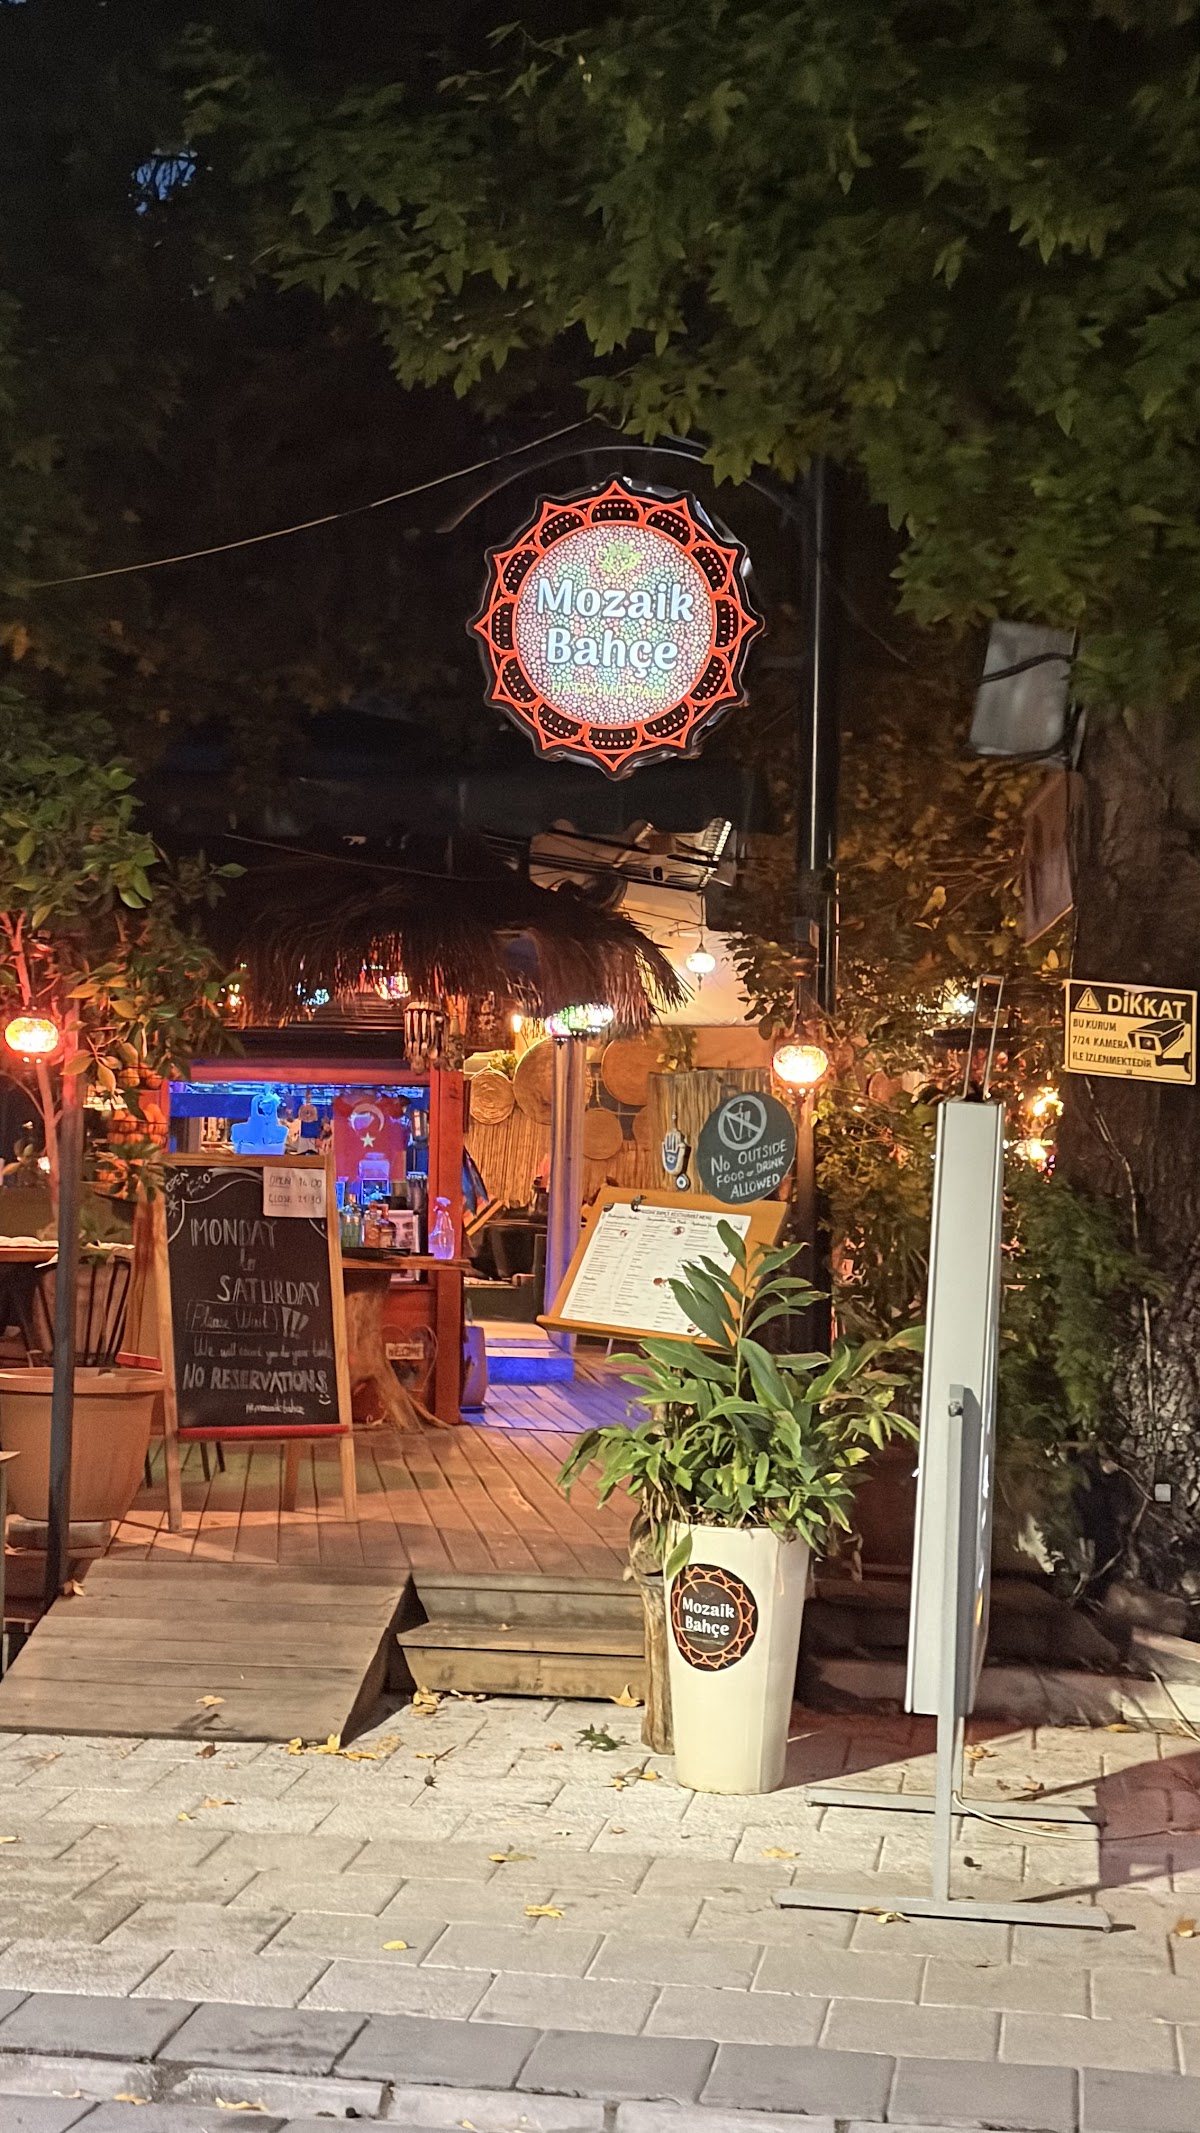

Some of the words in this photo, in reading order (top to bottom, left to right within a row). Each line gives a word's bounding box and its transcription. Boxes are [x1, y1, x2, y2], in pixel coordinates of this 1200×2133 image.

[537, 578, 694, 622] Mozaik
[546, 627, 679, 678] Bahçe
[552, 681, 599, 693] HATAY
[1107, 991, 1187, 1019] DİKKAT
[1073, 1018, 1084, 1028] BU
[1086, 1020, 1117, 1031] KURUM
[1073, 1035, 1090, 1045] 7/24
[1093, 1037, 1129, 1049] KAMERA
[737, 1138, 788, 1165] OUTSIDE
[166, 1169, 189, 1192] OPEN
[716, 1170, 745, 1188] FOOD
[756, 1156, 785, 1174] DRINK
[730, 1173, 781, 1199] ALLOWED
[191, 1218, 278, 1248] MONDAY
[217, 1275, 320, 1307] SATURDAY
[190, 1303, 231, 1330] Please
[194, 1335, 214, 1357] We
[182, 1363, 205, 1390] NO
[210, 1366, 328, 1394] RESERVATIONS
[682, 1597, 735, 1618] Mozaik
[685, 1615, 730, 1638] Bahçe
